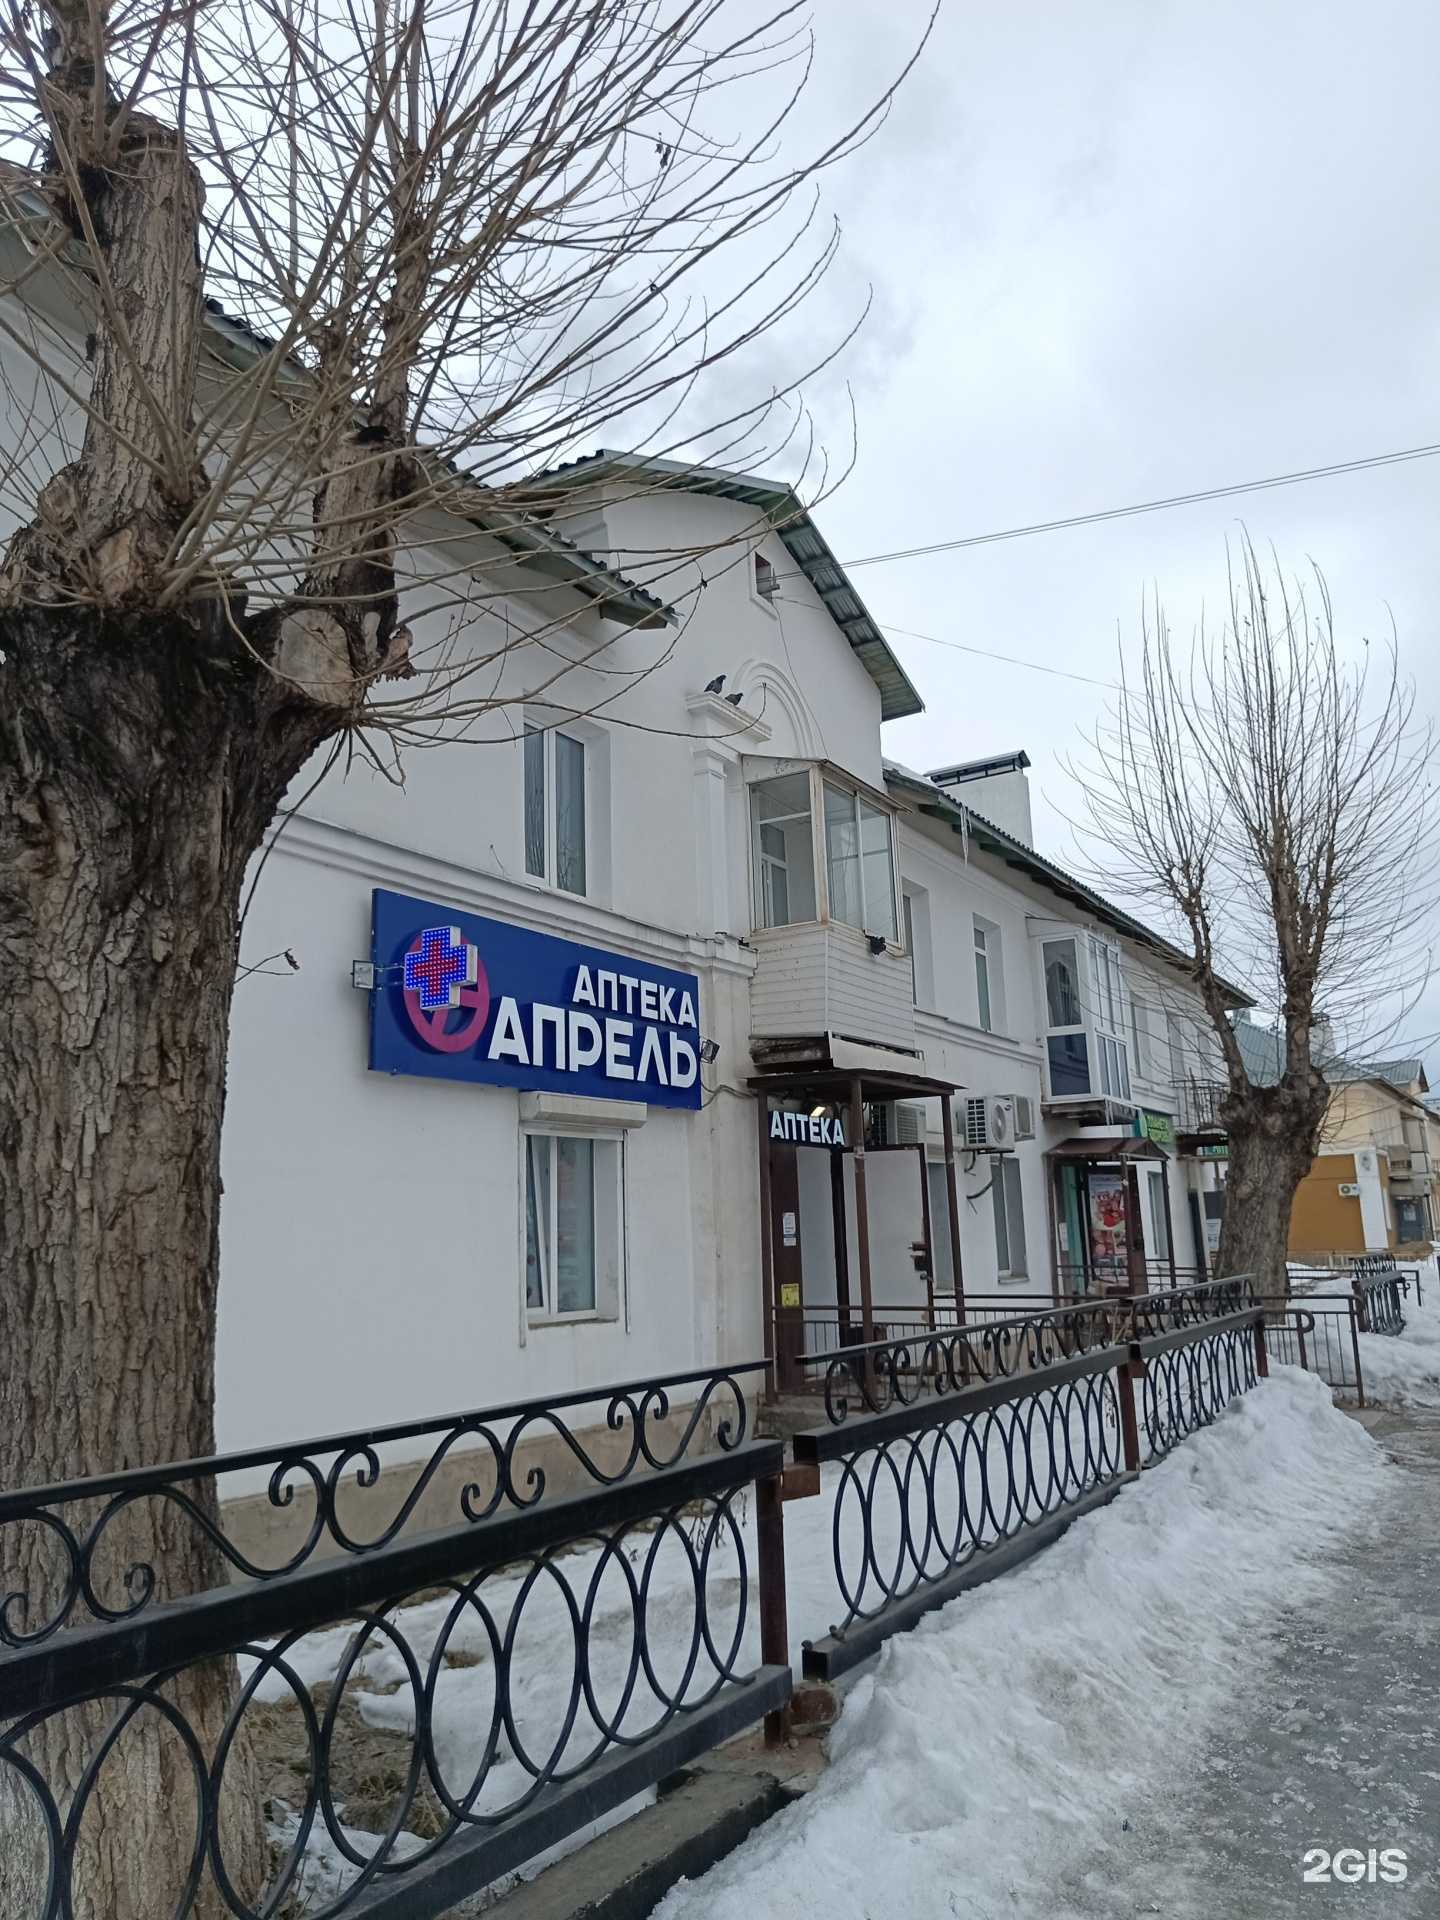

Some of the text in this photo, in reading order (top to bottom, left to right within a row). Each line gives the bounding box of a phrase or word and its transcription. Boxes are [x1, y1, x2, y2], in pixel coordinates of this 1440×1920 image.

[572, 964, 698, 1029] АПТЕКА
[487, 996, 698, 1089] АПРЕЛЬ
[770, 1110, 845, 1146] АПТЕКА
